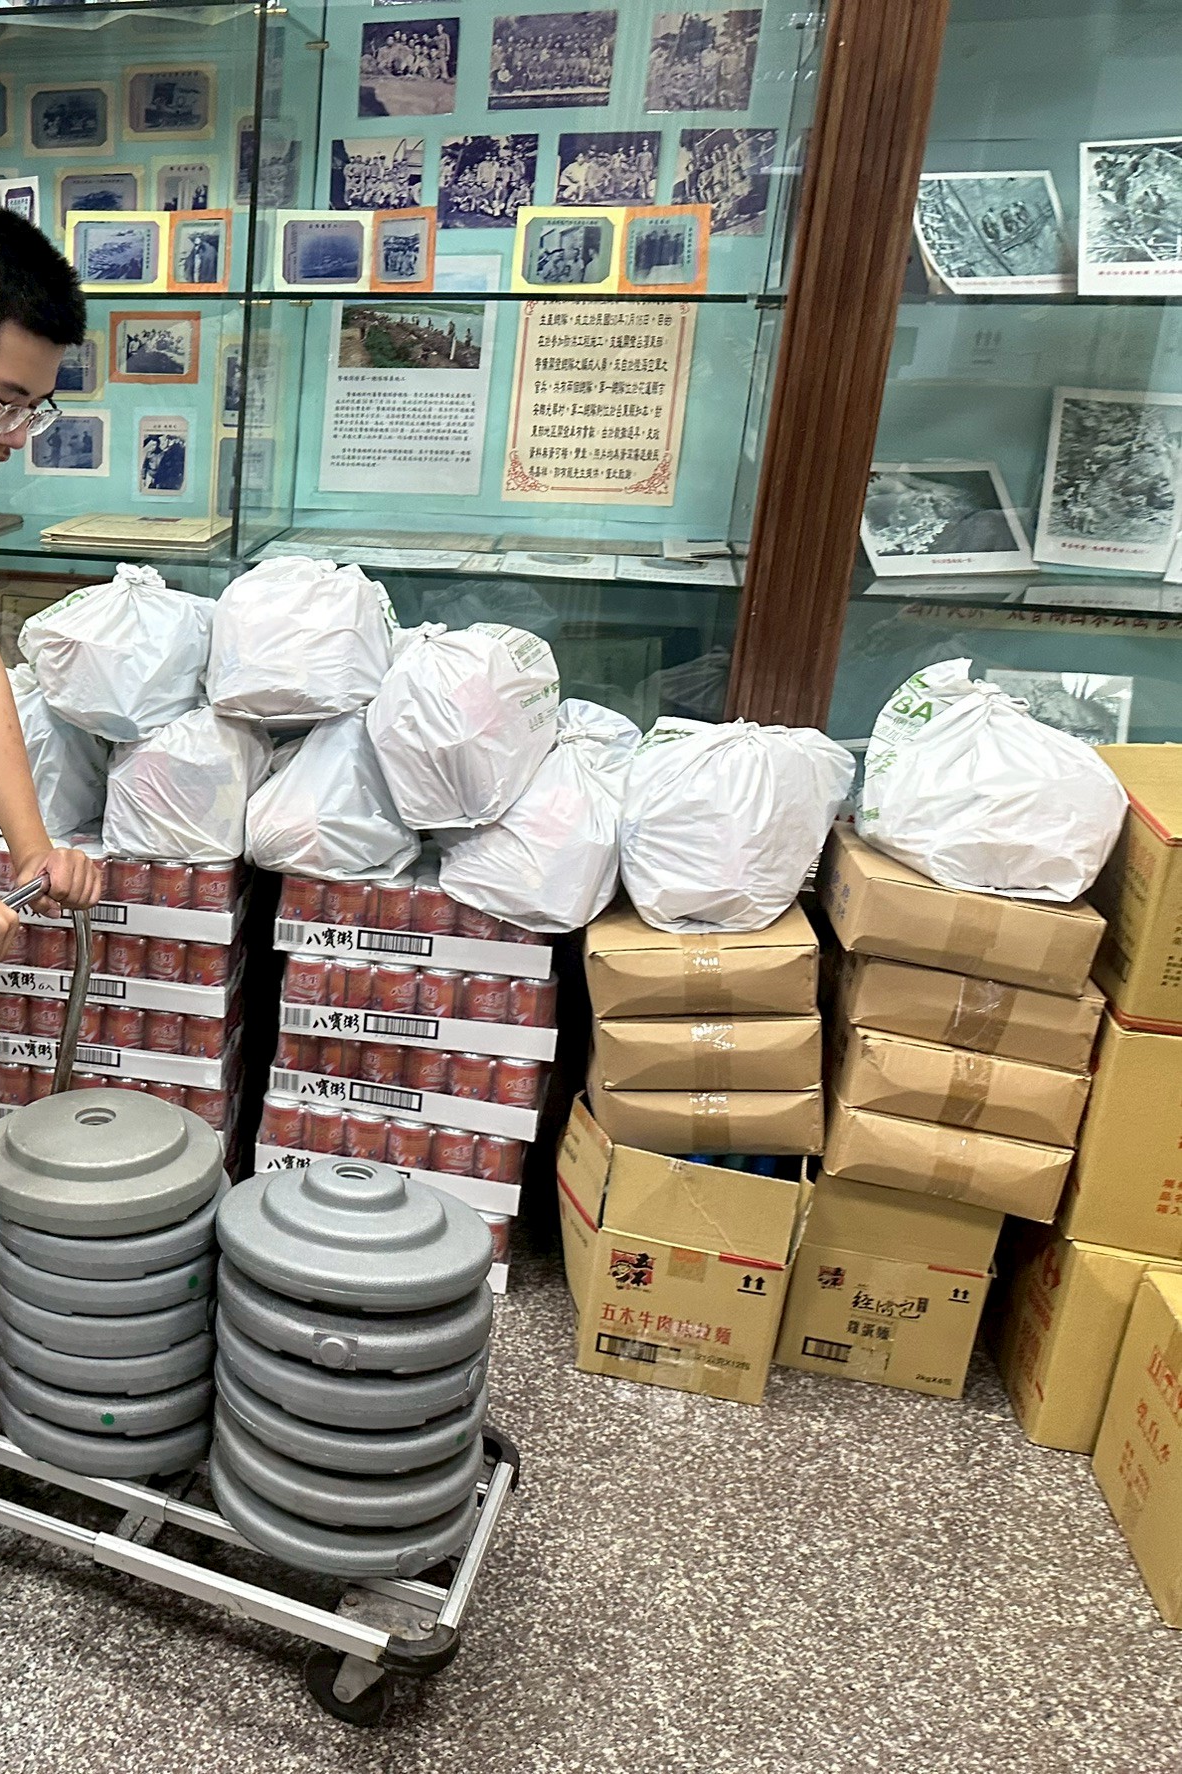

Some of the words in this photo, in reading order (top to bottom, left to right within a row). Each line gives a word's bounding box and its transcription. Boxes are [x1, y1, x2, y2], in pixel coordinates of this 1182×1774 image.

[306, 928, 354, 950] 八寶粥
[313, 1012, 359, 1033] 八寶粥
[12, 1040, 53, 1061] 八寶粥
[300, 1079, 346, 1100] 八寶粥
[847, 1320, 891, 1341] 雞蛋麵
